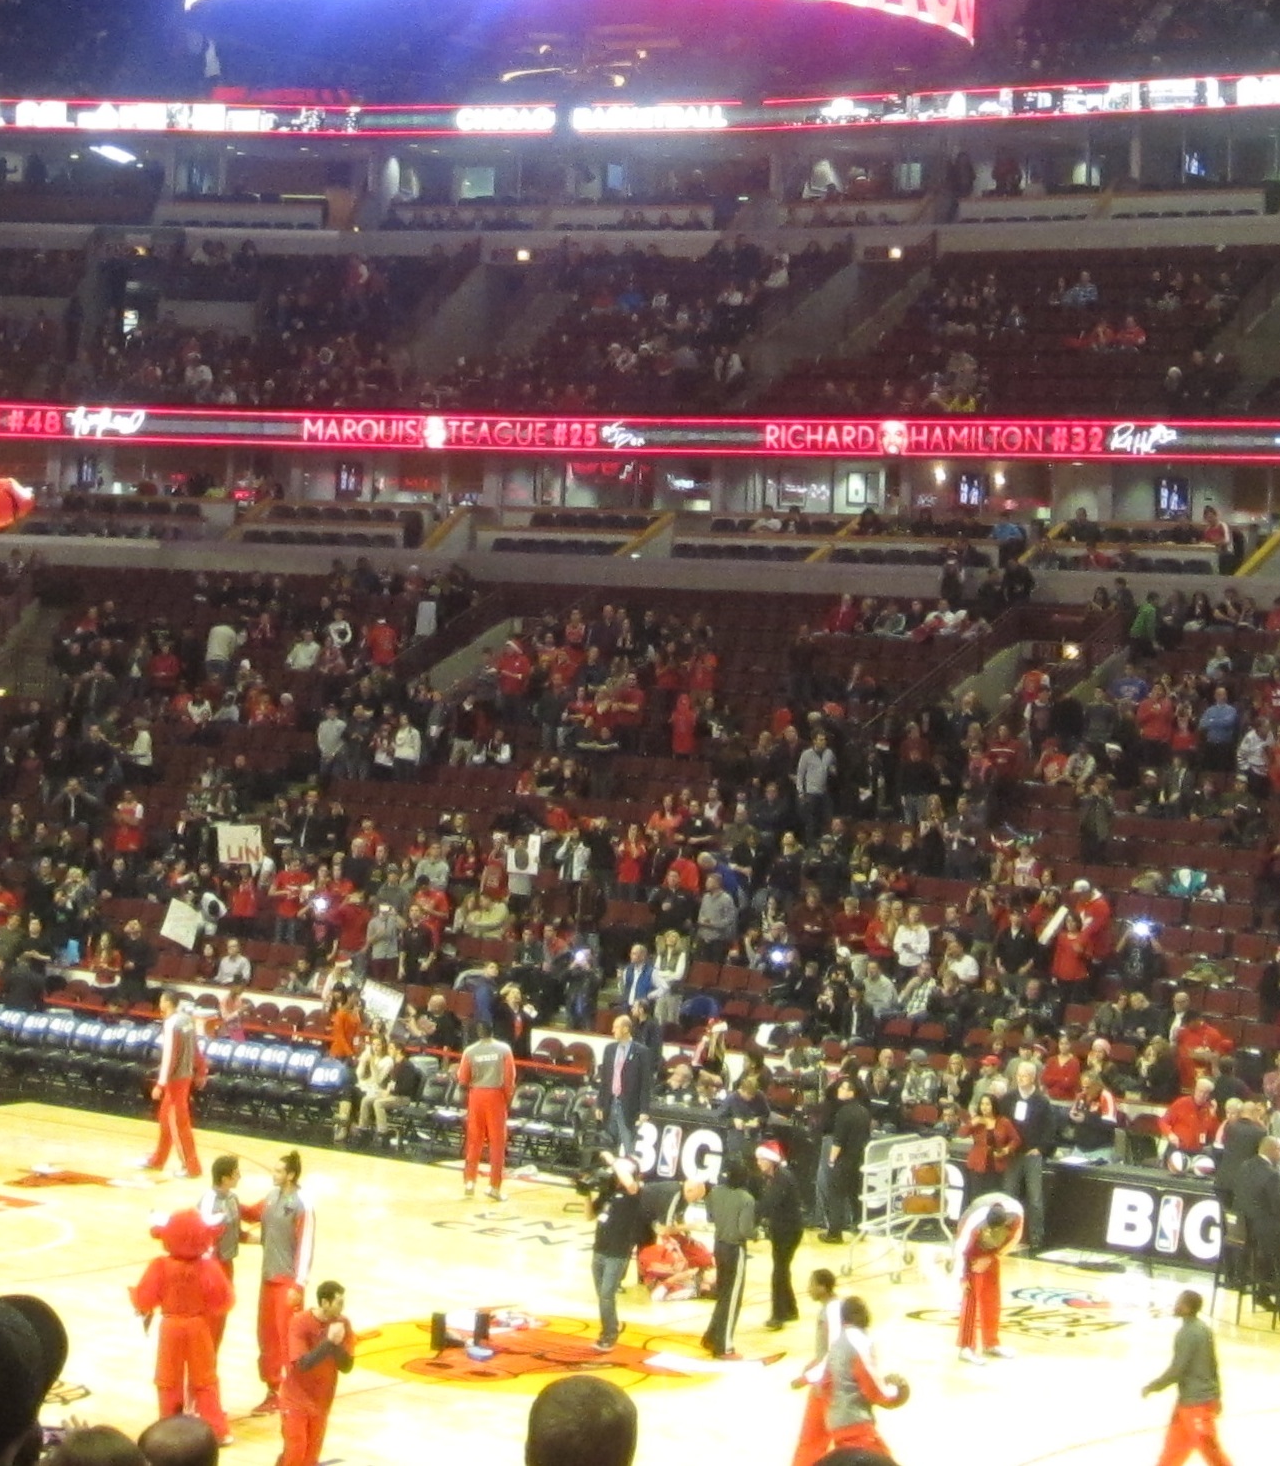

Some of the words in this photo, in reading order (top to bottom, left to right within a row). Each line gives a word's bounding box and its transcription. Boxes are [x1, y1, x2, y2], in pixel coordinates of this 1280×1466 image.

[7, 409, 61, 434] #48
[303, 417, 418, 445] MARQUIS
[447, 421, 547, 447] TEAGUE
[553, 422, 597, 448] #25
[765, 424, 875, 451] RICHARD
[907, 425, 1044, 452] HAMILTON
[1051, 426, 1103, 452] #32
[227, 844, 262, 863] LIN
[1105, 1186, 1222, 1261] BIG
